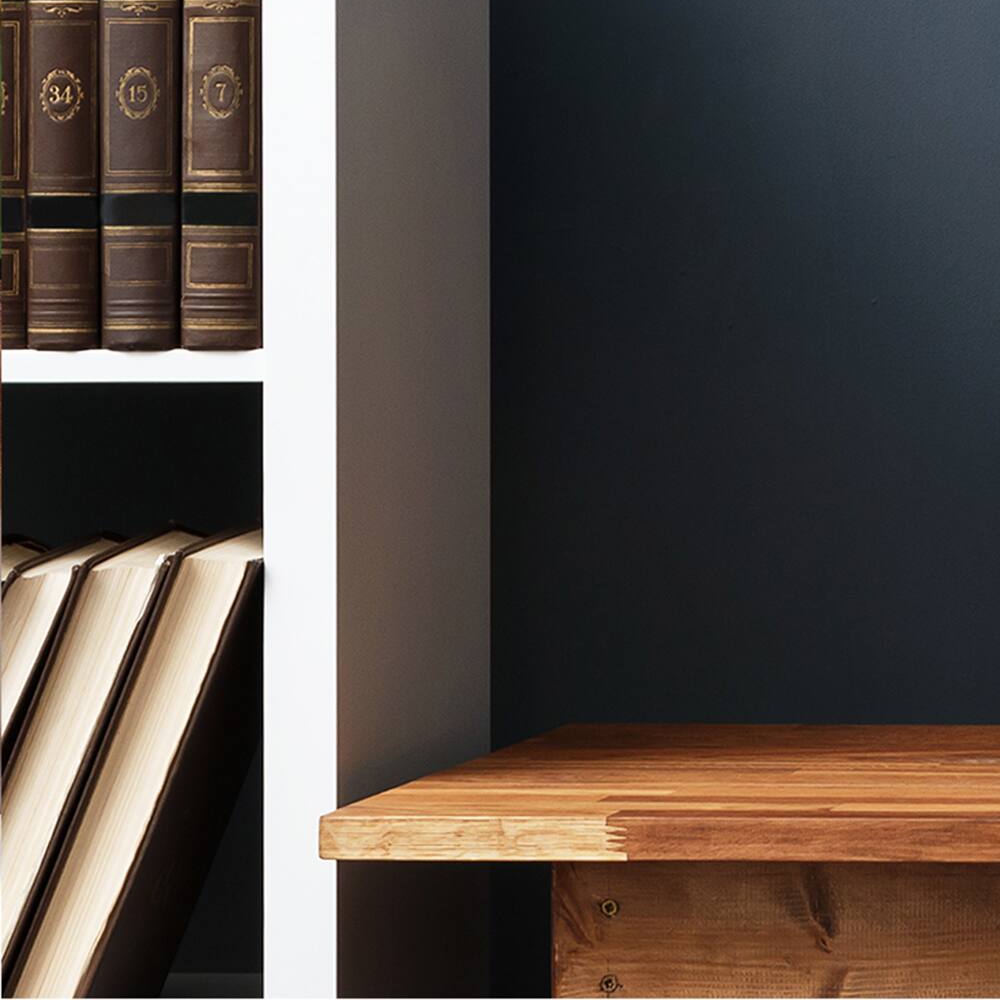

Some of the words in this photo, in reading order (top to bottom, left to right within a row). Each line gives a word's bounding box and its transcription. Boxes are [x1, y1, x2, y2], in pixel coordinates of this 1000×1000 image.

[49, 85, 73, 104] 34
[128, 84, 148, 103] 15
[215, 82, 226, 102] 7
